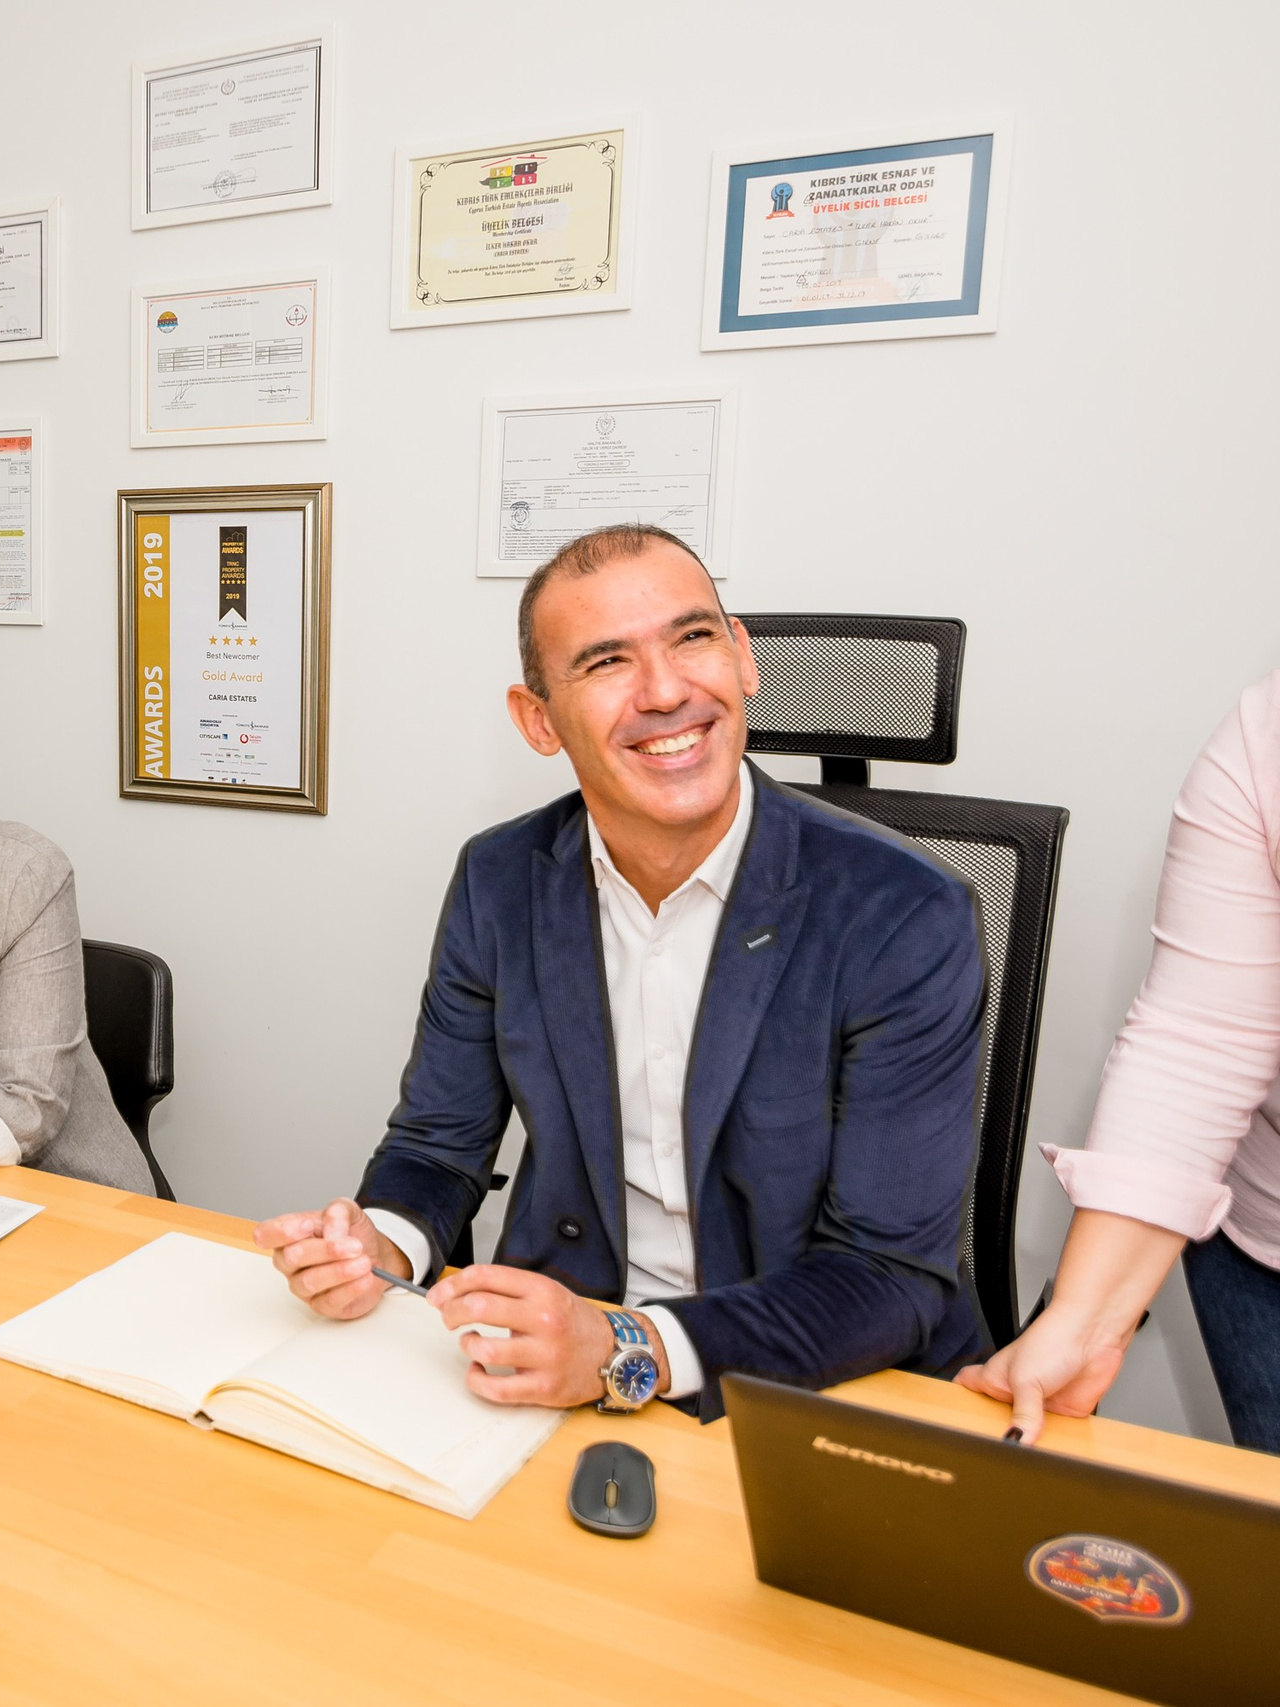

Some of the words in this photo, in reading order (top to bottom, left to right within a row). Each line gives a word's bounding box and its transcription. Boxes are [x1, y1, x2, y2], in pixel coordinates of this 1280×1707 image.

[810, 176, 846, 188] KIBRIS
[850, 171, 878, 184] TÜRK
[882, 167, 918, 180] ESNAF
[921, 166, 935, 175] VE
[900, 179, 934, 191] ODASI
[813, 199, 851, 214] ÜYELİK
[853, 196, 880, 210] SİCİL
[883, 192, 928, 207] BELGESİ
[143, 532, 163, 598] 2019
[223, 652, 260, 660] Newcomer
[202, 670, 227, 681] Gold
[230, 672, 263, 682] Award
[229, 695, 257, 703] ESTATES
[144, 665, 163, 779] AWARDS
[812, 1436, 955, 1484] lenovo
